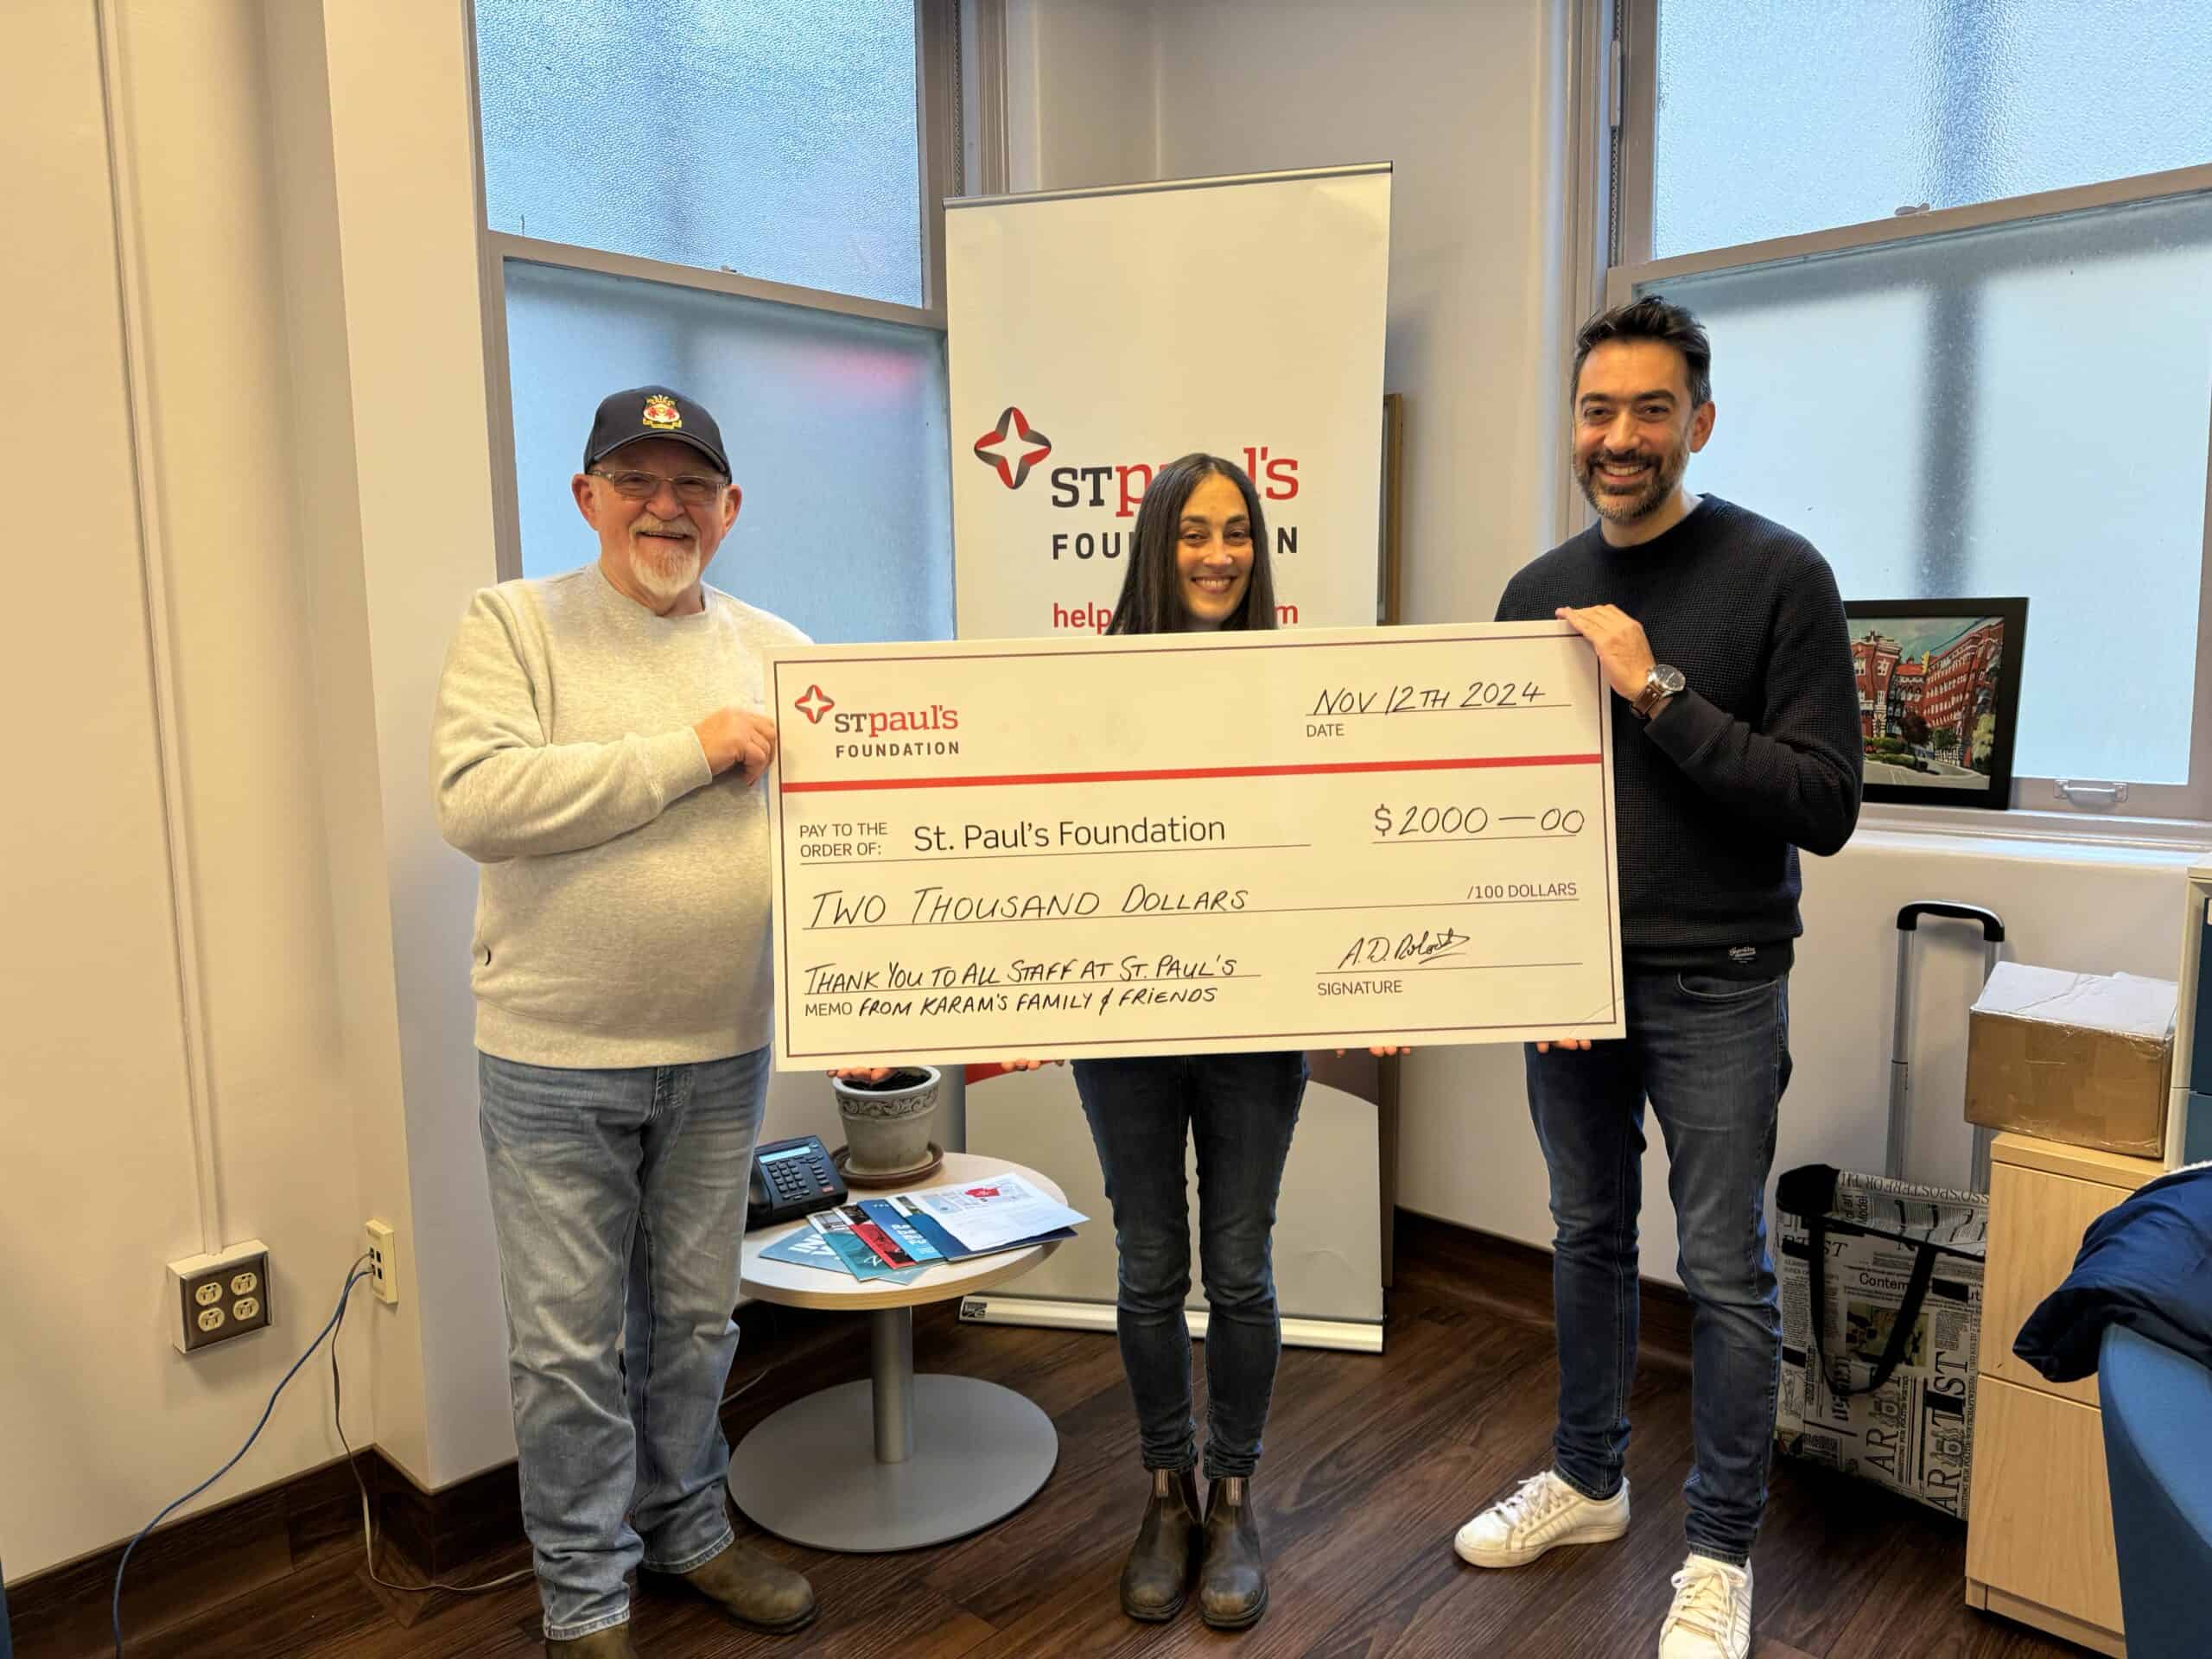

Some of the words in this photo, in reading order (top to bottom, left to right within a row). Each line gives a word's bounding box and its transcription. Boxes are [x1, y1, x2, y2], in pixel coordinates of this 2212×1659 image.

[1313, 688, 1377, 715] NOV
[1384, 685, 1450, 715] 12TH
[1460, 682, 1545, 708] 2024
[1306, 724, 1344, 738] DATE
[836, 741, 959, 759] FOUNDATION
[799, 823, 831, 838] PAY
[834, 823, 852, 836] TO
[857, 822, 887, 836] THE
[914, 825, 954, 851] St.
[964, 822, 1050, 850] Paul's
[1059, 816, 1224, 847] Foundation
[800, 842, 852, 857] ORDER
[856, 842, 882, 855] OF:
[1466, 885, 1504, 900] /100
[1508, 882, 1577, 898] DOLLARS
[810, 890, 886, 928] TWO
[912, 887, 1101, 925] THOUSAND
[1122, 884, 1248, 914] DOLLARS
[804, 963, 879, 993] THANK
[888, 962, 923, 987] YOU
[931, 967, 957, 988] TO
[961, 963, 1001, 986] ALL
[1007, 959, 1077, 983] STAFF
[1080, 961, 1114, 982] AT
[1120, 956, 1147, 981] ST.
[1156, 953, 1236, 978] PAUL'S
[1317, 980, 1403, 996] SIGNATURE
[804, 1001, 853, 1017] MEMO
[859, 999, 912, 1018] FROM
[920, 993, 1008, 1015] KARAM'S
[1016, 991, 1092, 1012] FAMILY
